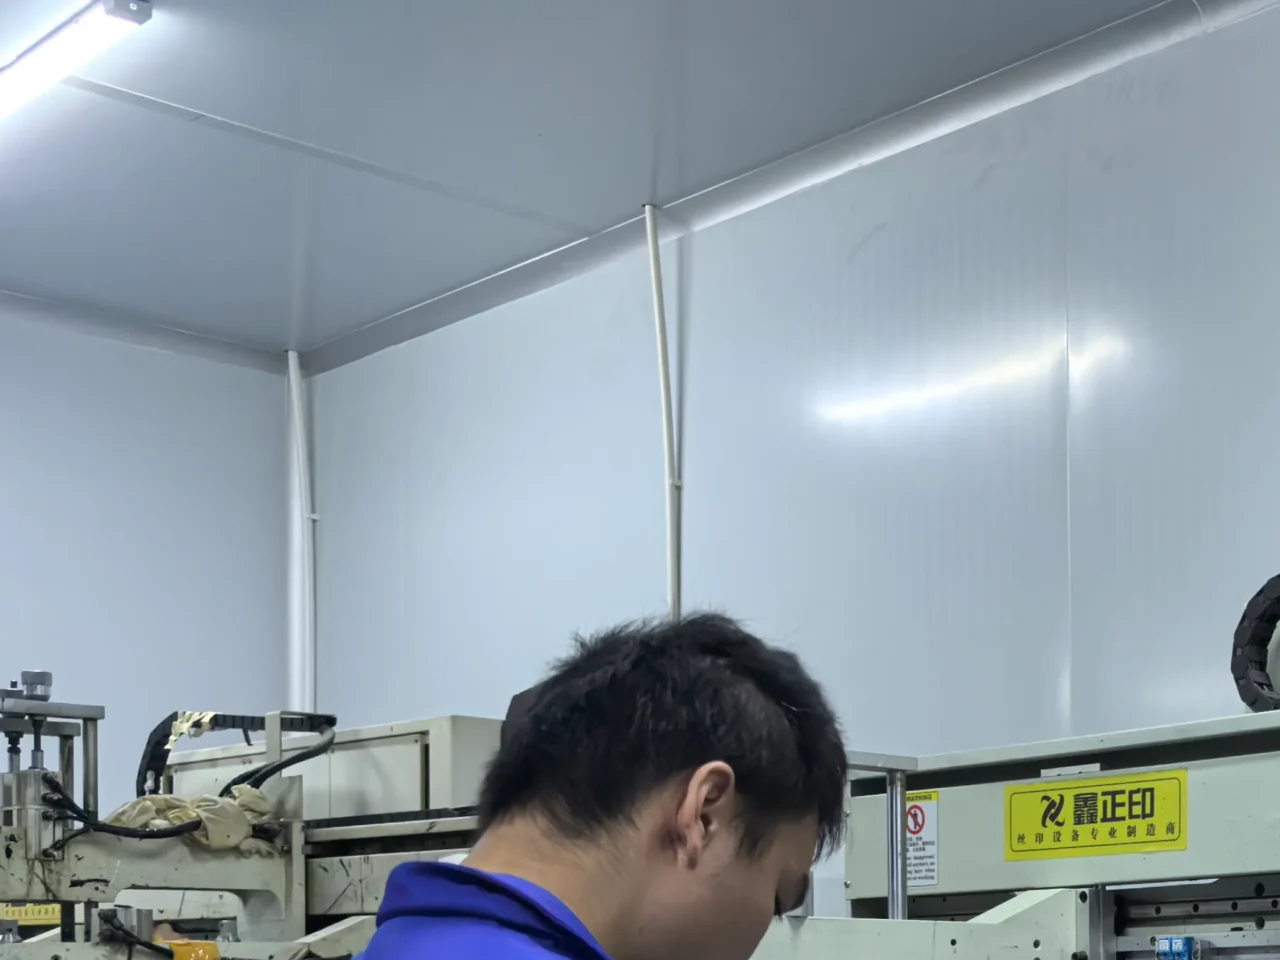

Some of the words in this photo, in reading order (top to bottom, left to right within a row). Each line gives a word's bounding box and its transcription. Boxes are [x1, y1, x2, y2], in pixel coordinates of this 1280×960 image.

[1073, 787, 1155, 826] 鑫正印
[1016, 821, 1176, 845] 丝印设备专业制造商
